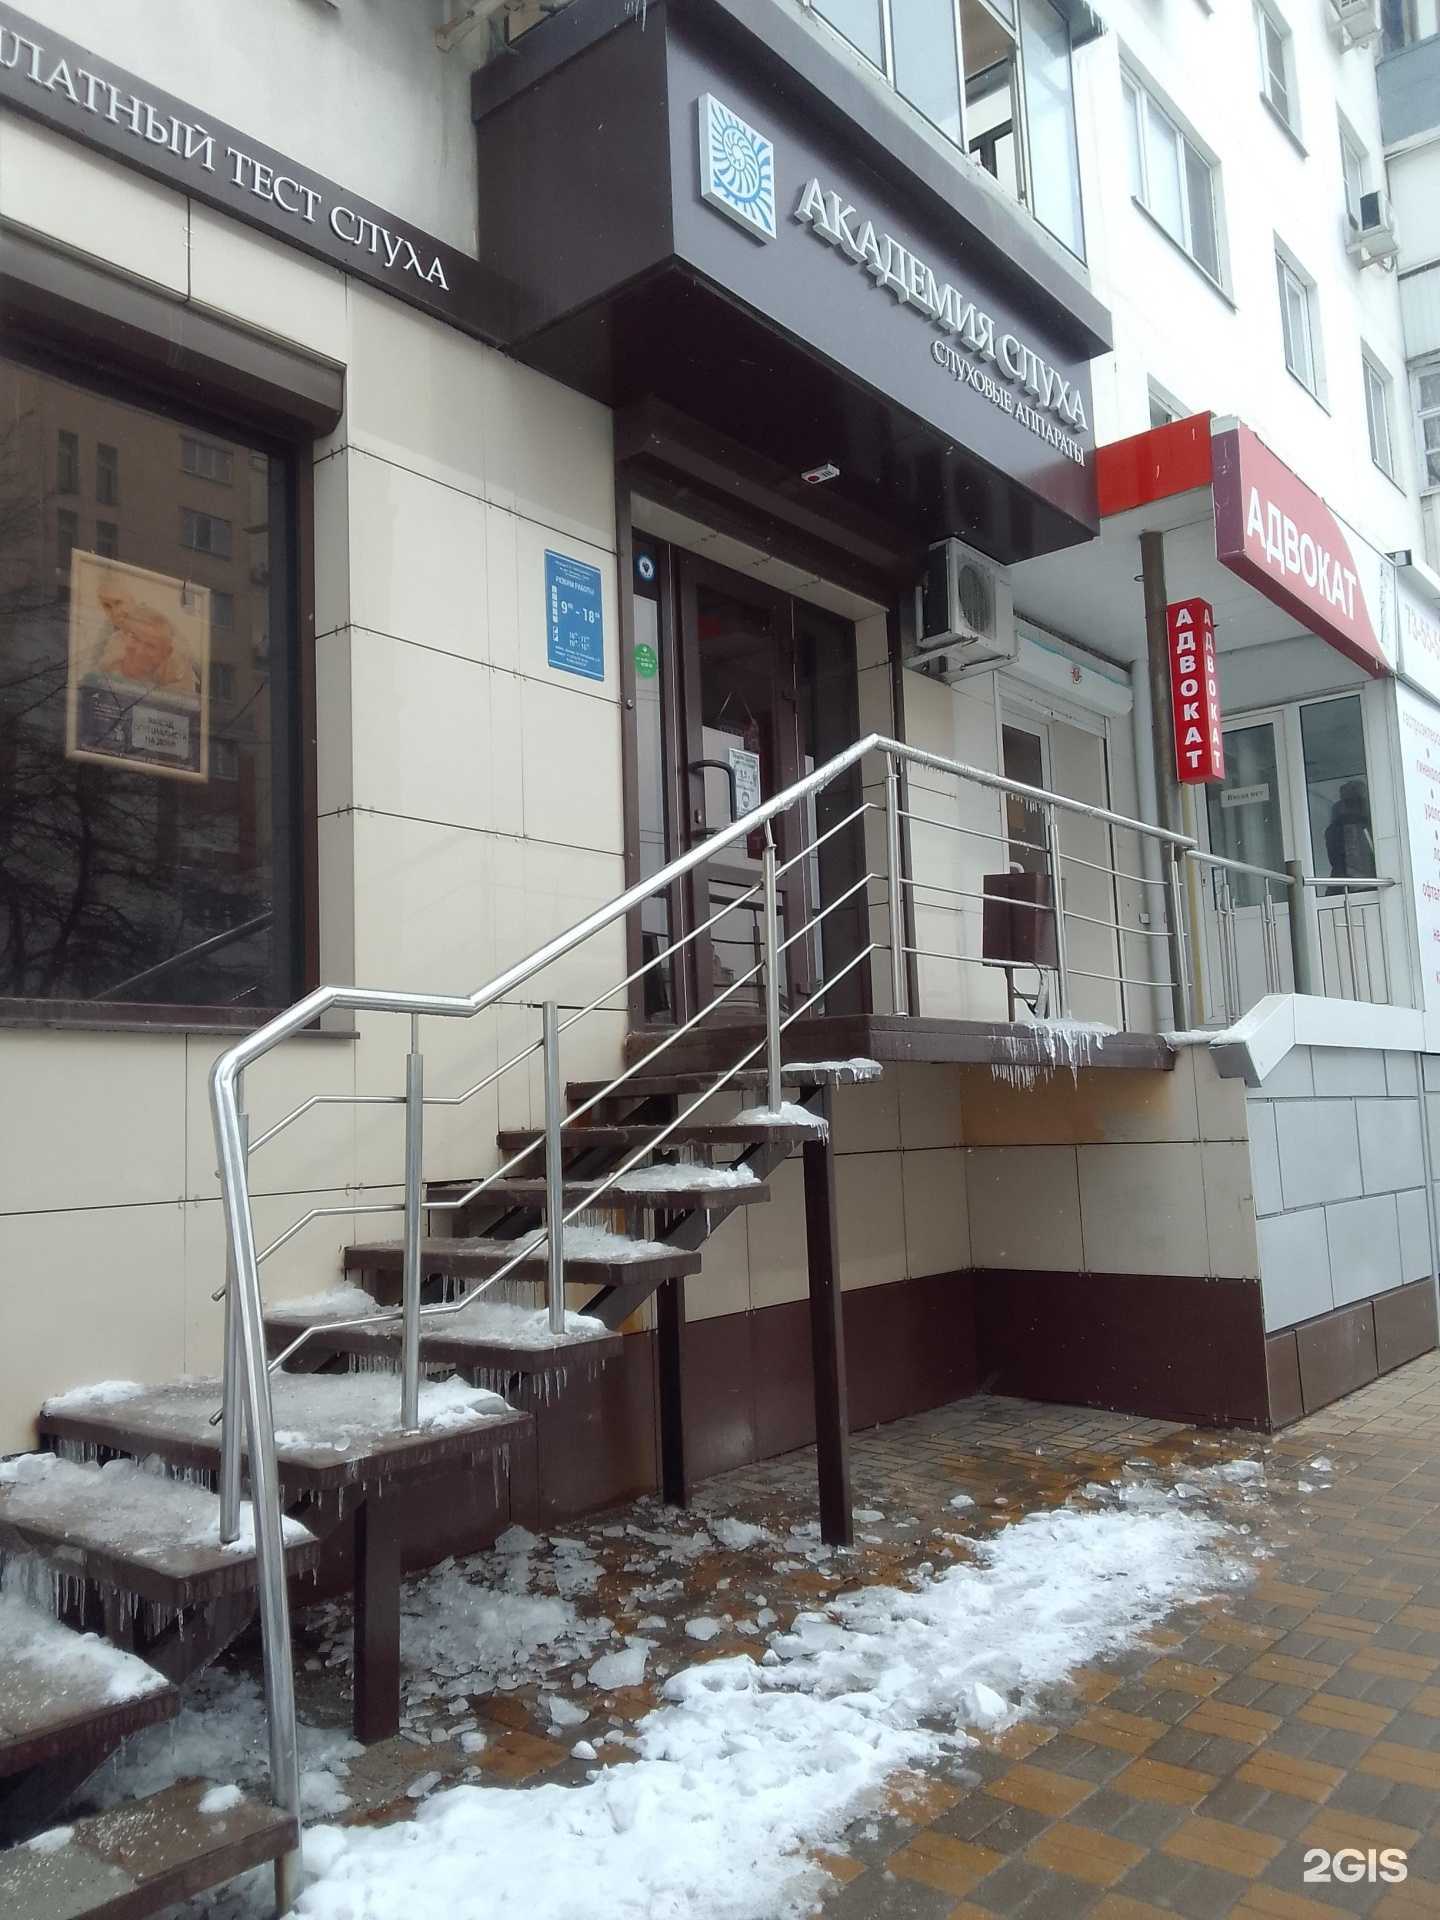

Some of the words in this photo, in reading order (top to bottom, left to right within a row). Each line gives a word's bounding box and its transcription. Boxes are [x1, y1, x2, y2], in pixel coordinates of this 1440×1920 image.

[226, 146, 323, 224] ТЕСТ
[330, 206, 451, 293] СЛУХА
[794, 177, 997, 362] АКАДЕМИЯ
[995, 333, 1089, 432] СЛУХА
[932, 339, 1014, 416] СЛУХОВЫЕ
[1014, 401, 1086, 468] АППАРАТЫ
[1246, 486, 1357, 620] АДВОКАТ
[1175, 608, 1203, 769] АДВОКАТ
[1203, 608, 1221, 769] АДВОКАТ
